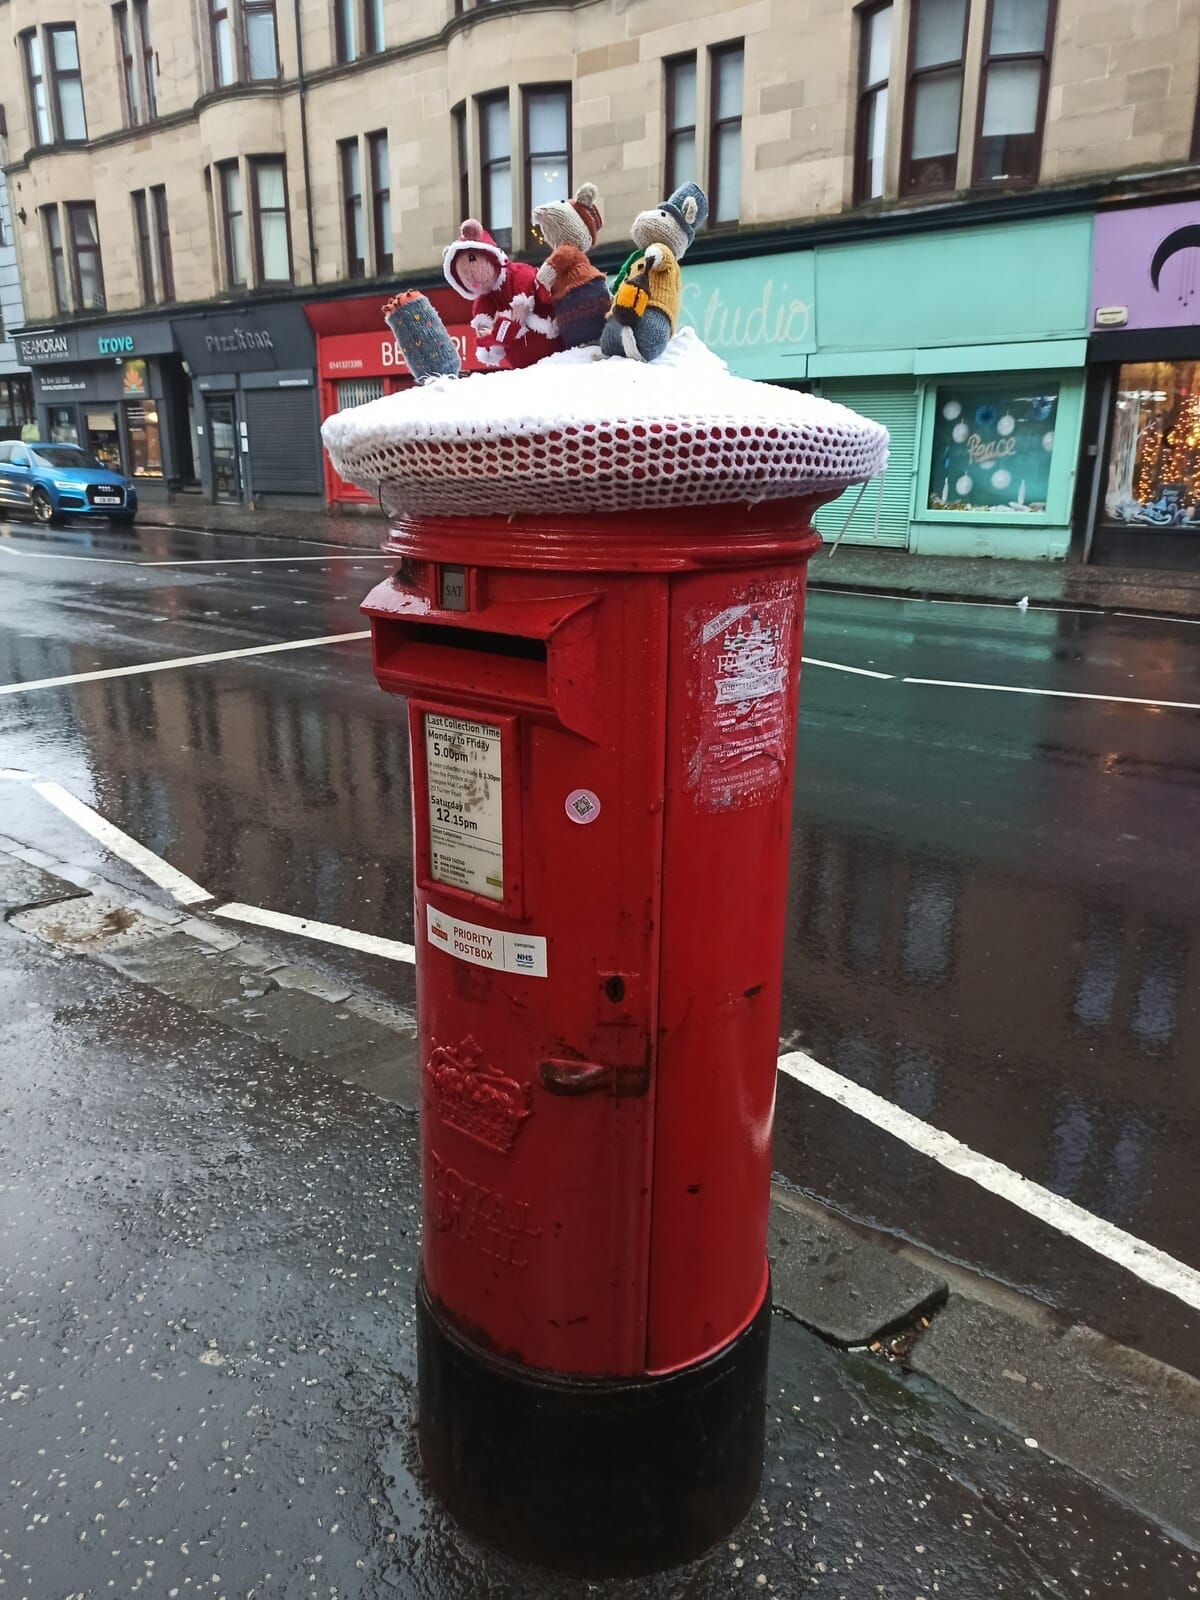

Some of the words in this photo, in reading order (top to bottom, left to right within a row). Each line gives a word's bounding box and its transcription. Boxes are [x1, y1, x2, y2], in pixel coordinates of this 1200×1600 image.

[679, 279, 814, 346] Studio
[97, 335, 134, 354] trove
[967, 433, 1016, 464] Peace
[445, 584, 464, 597] SAT
[427, 713, 443, 726] Last
[444, 718, 480, 733] Collection
[481, 724, 500, 737] Time
[428, 728, 456, 744] Monday
[457, 735, 465, 745] to
[466, 737, 490, 752] Friday
[433, 742, 469, 763] 5.00pm
[431, 795, 463, 812] Saturday
[436, 807, 478, 830] 12.15pm
[453, 926, 493, 947] PRIORITY
[454, 940, 493, 961] POSTBOX
[516, 952, 533, 962] NHS
